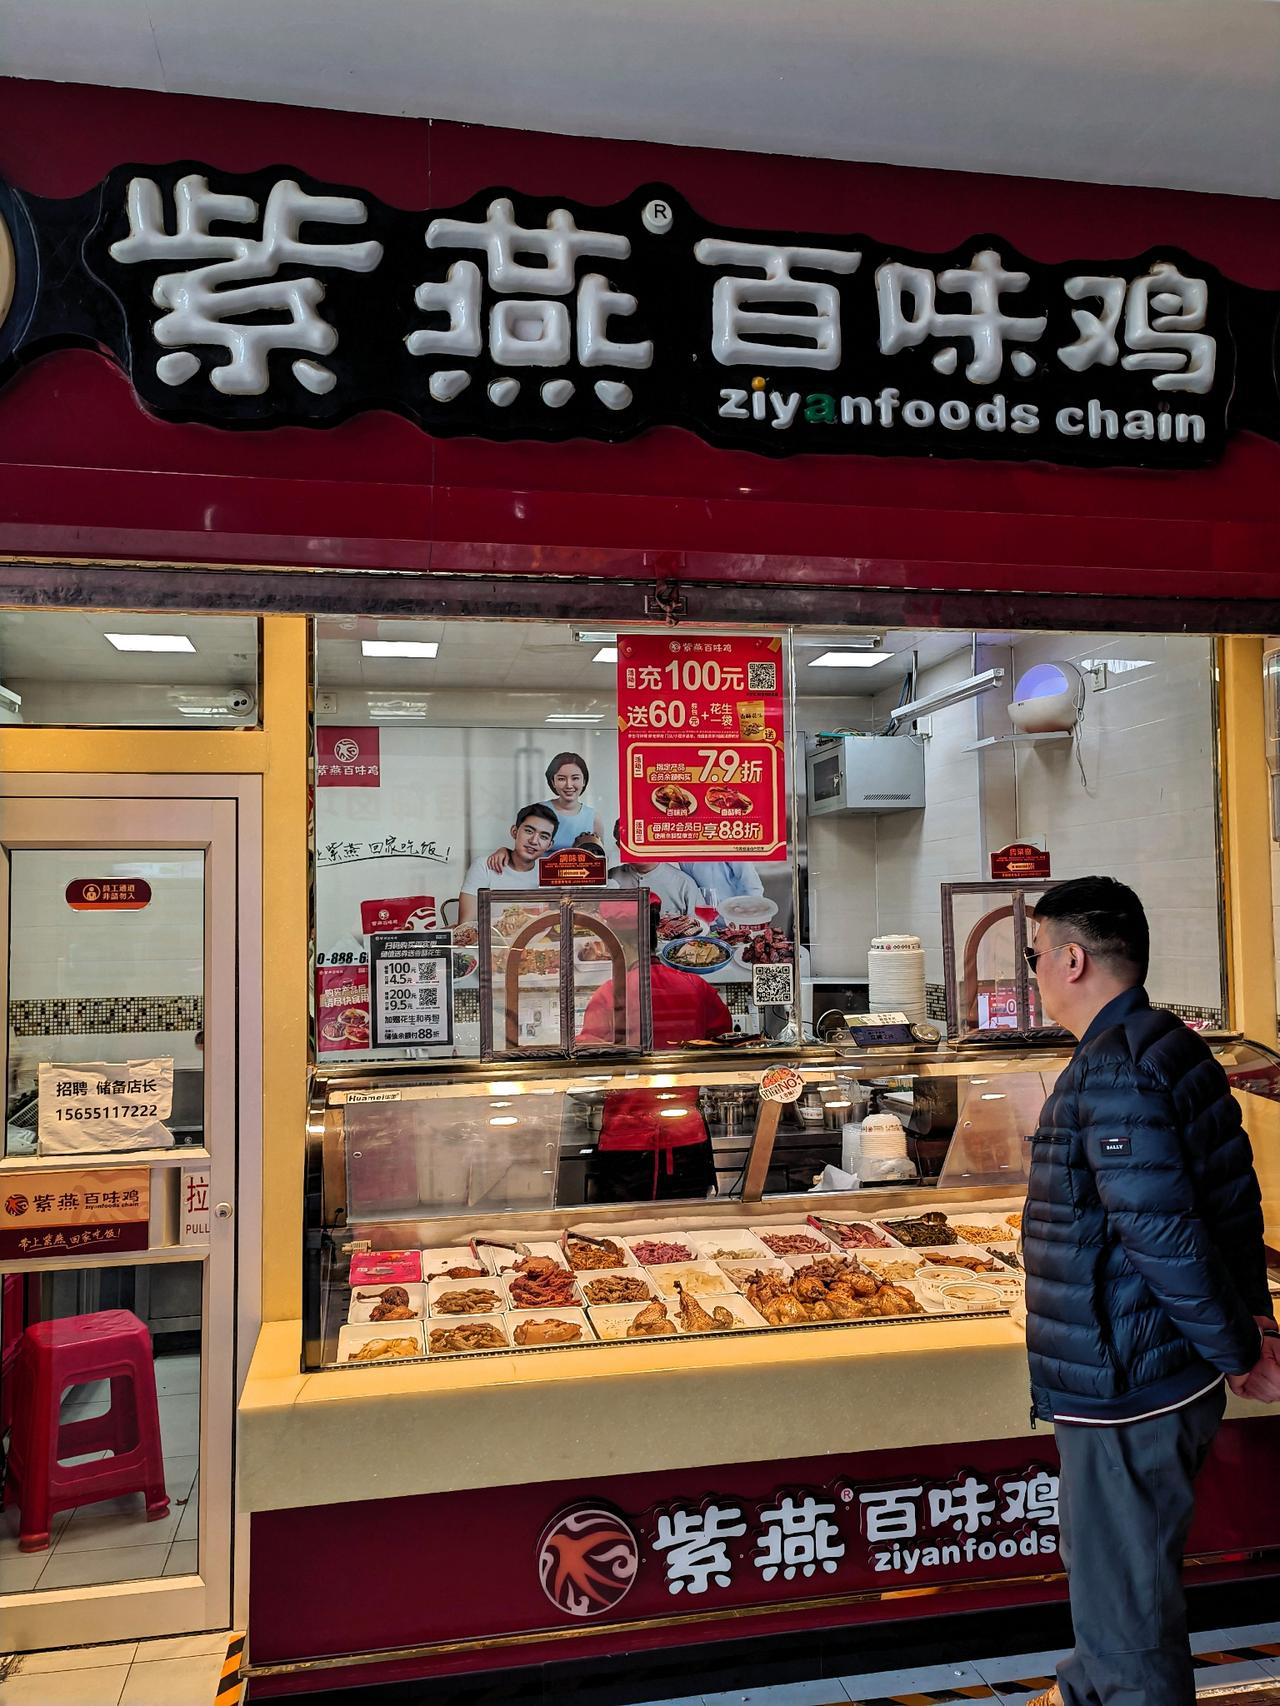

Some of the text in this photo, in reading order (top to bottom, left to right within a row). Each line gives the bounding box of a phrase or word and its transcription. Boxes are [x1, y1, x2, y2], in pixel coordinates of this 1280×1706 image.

[718, 377, 1206, 443] ziyanfoods chain
[638, 660, 744, 691] 充100元
[698, 749, 763, 782] 7.9折
[56, 1079, 157, 1097] 招聘 储备店长
[56, 1104, 158, 1121] 15655117222
[187, 1177, 209, 1213] 拉
[186, 1224, 210, 1234] PULL
[874, 1530, 1057, 1574] ziyanfoods
